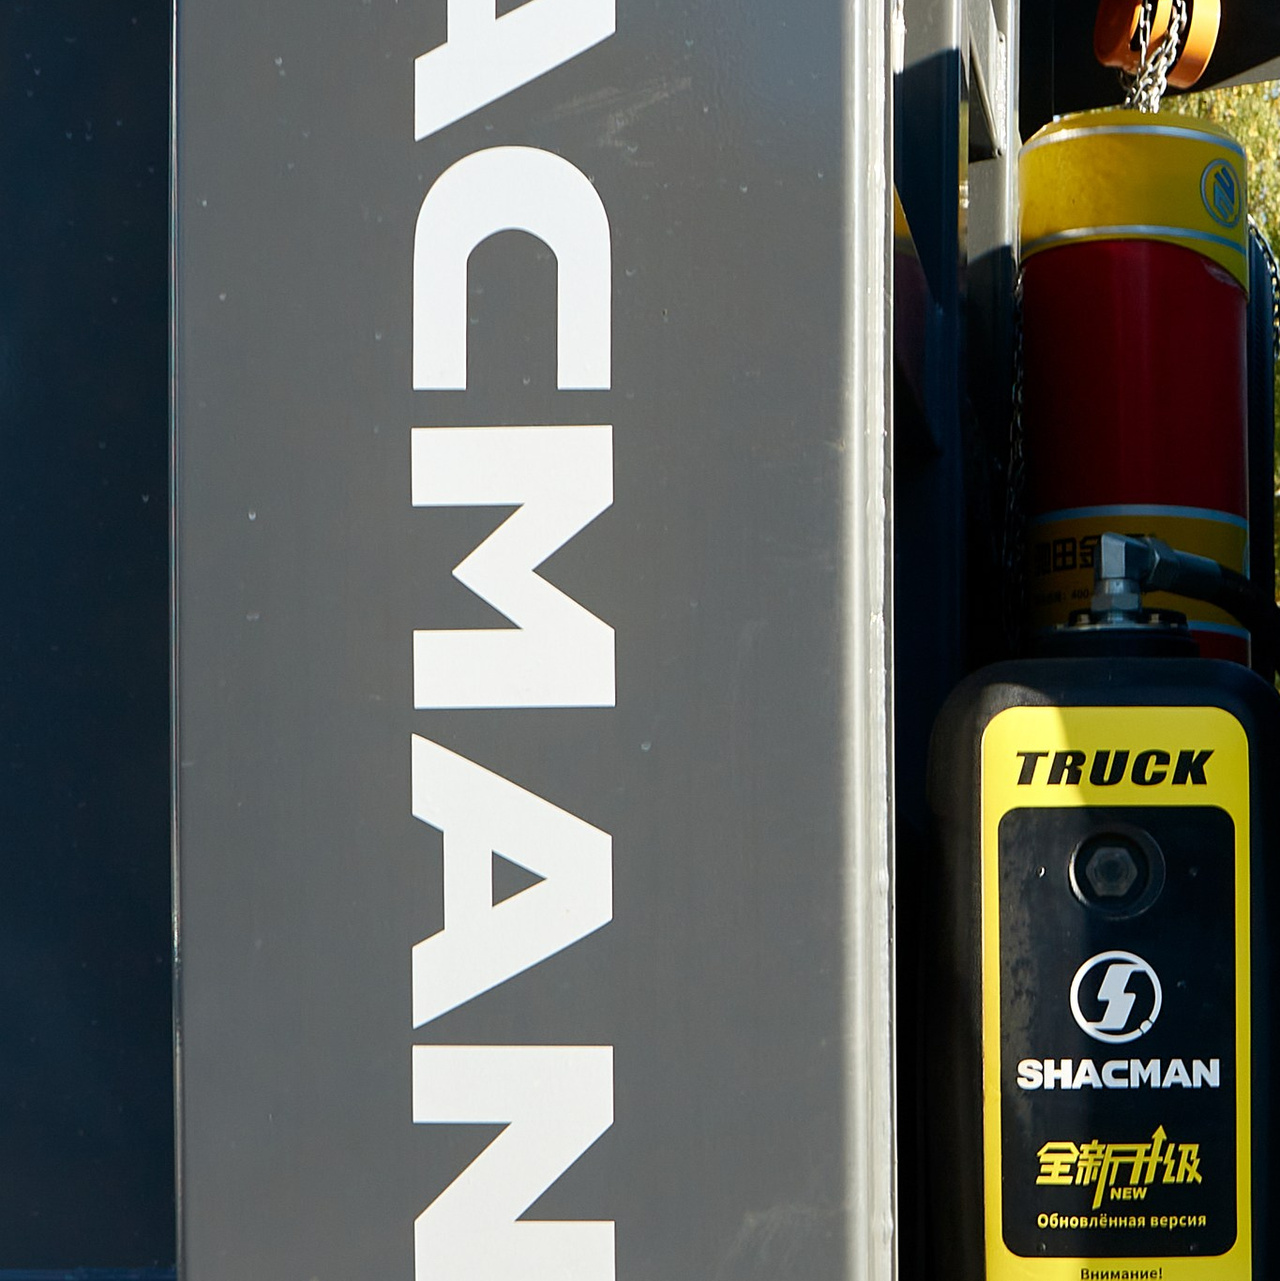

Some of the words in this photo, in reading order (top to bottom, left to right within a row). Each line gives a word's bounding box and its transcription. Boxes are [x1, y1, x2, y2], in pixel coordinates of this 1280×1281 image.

[1016, 748, 1216, 787] TRUCK
[1017, 1058, 1220, 1090] SHACMAN
[1110, 1187, 1148, 1201] NEW
[1037, 1212, 1146, 1229] Обновлённая
[1150, 1214, 1207, 1231] версия
[1080, 1267, 1163, 1280] Внимание!
